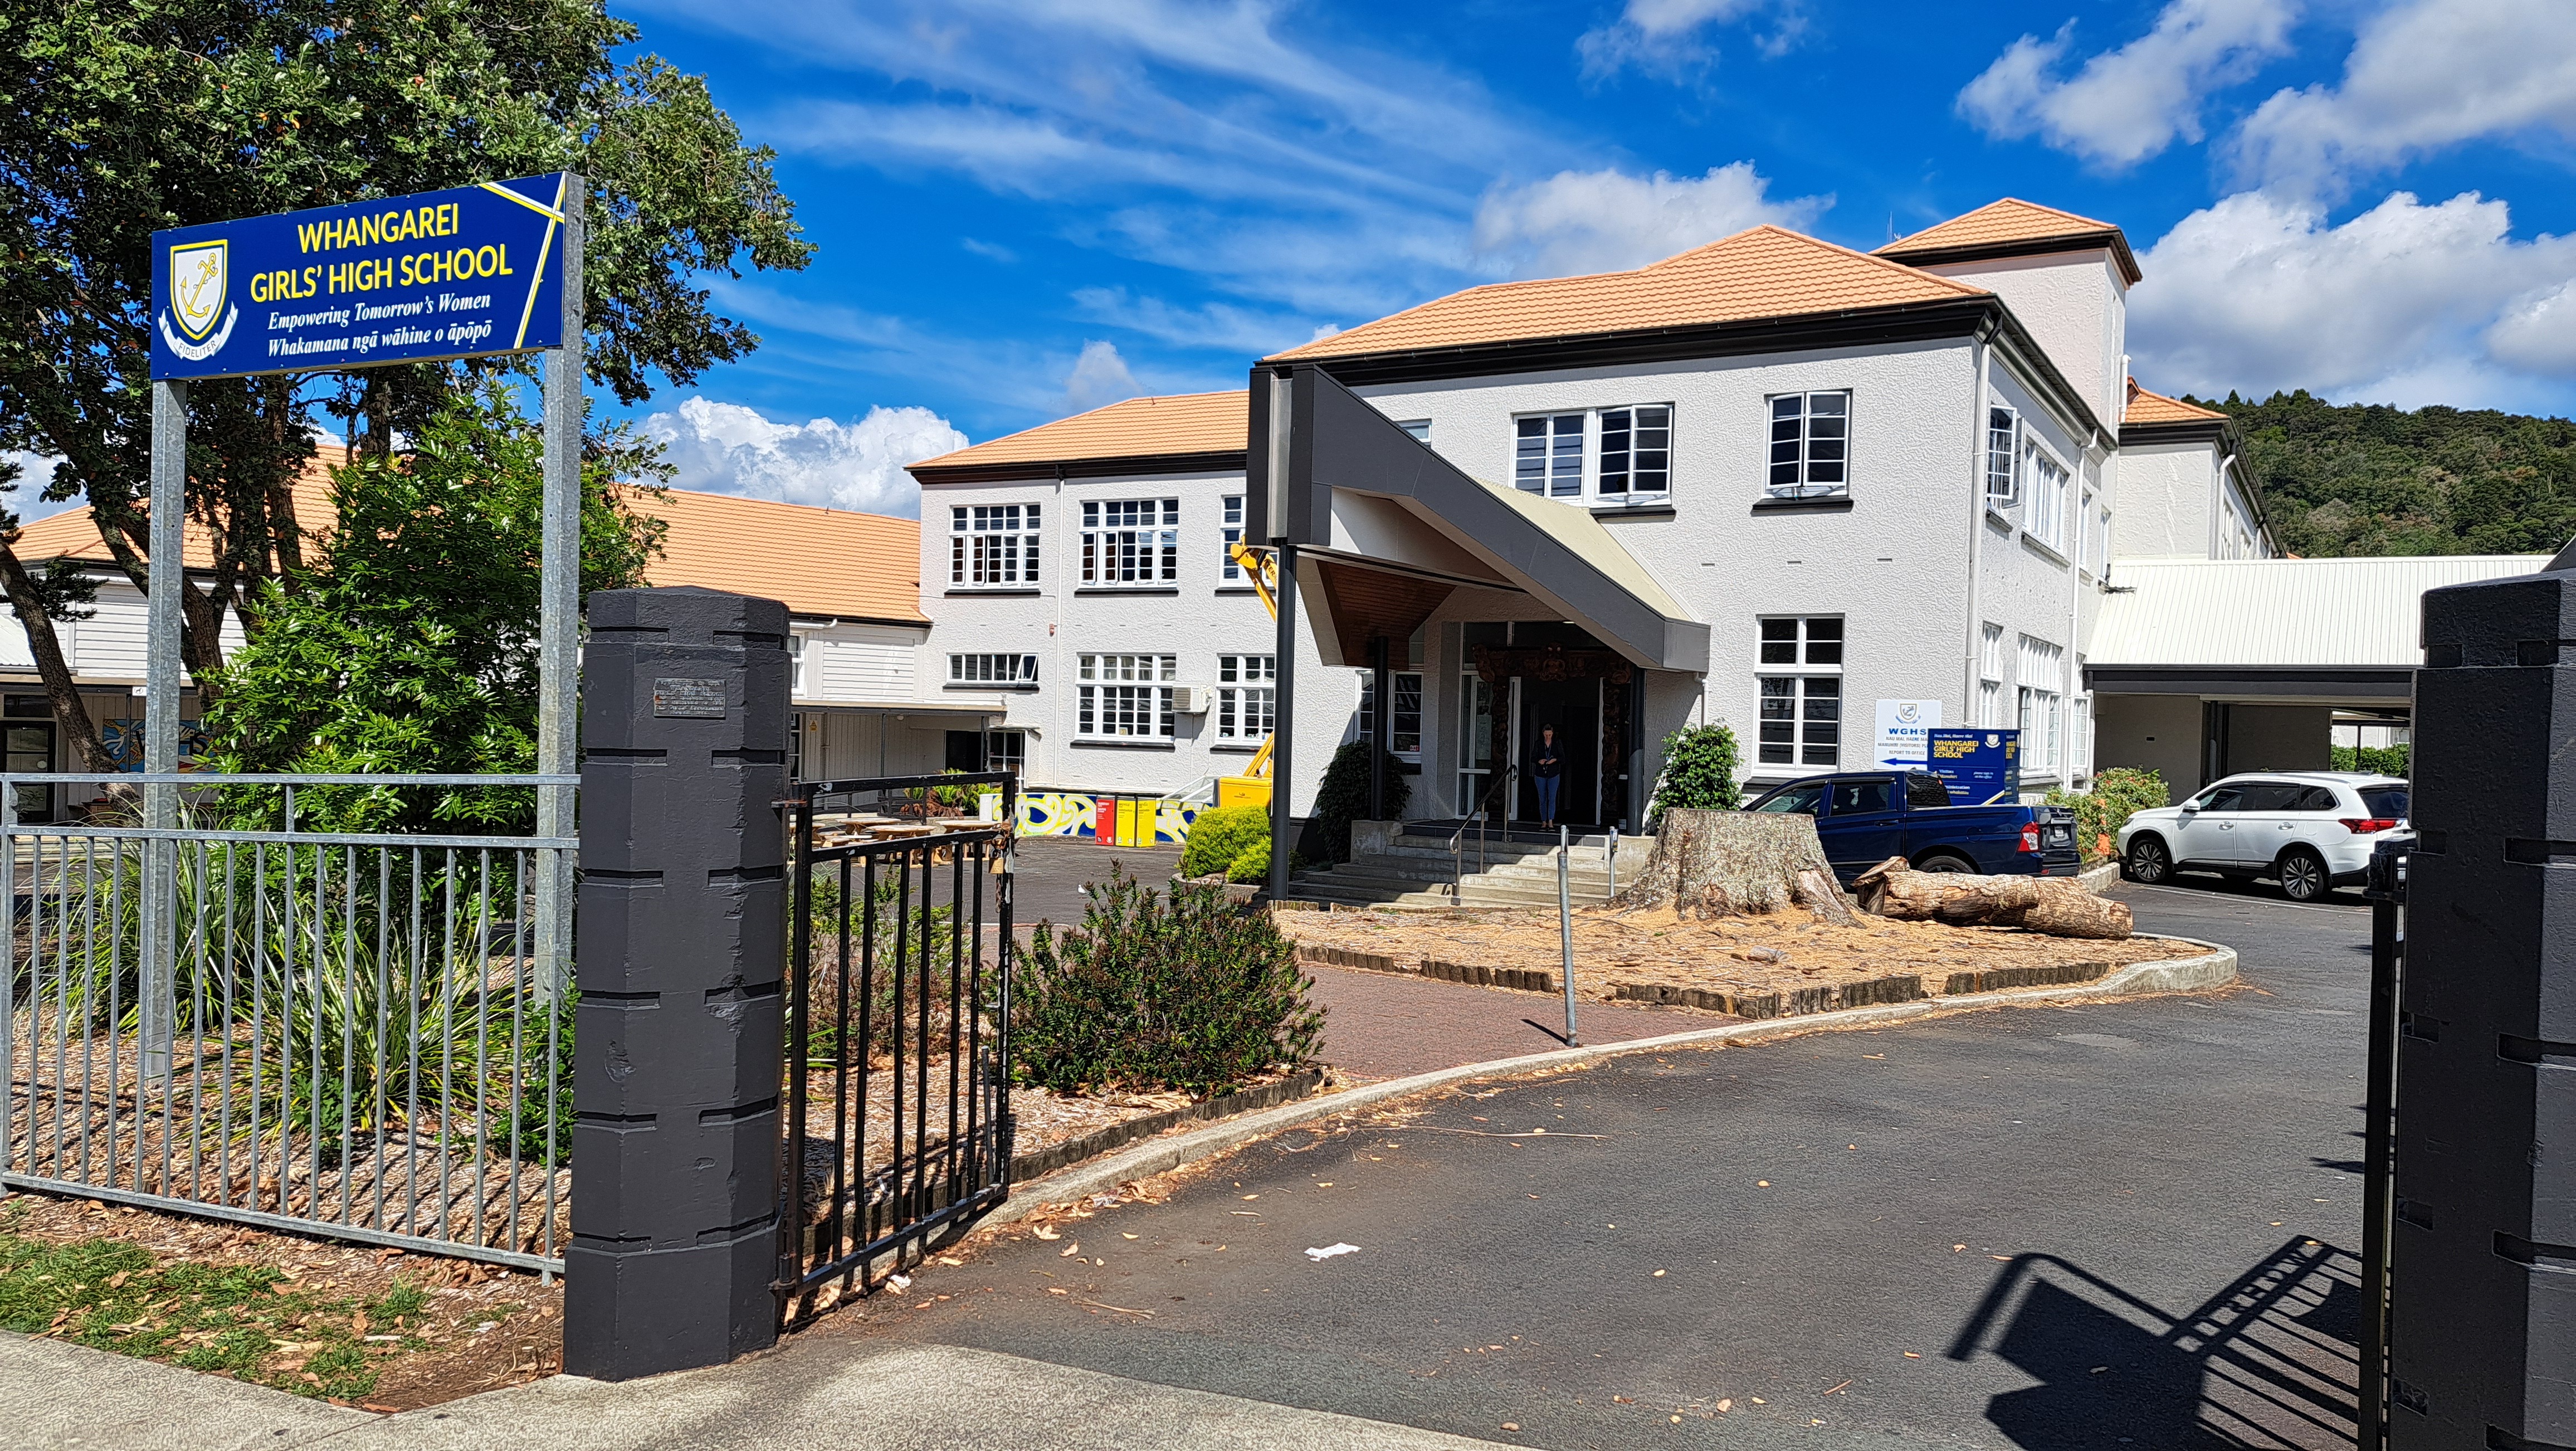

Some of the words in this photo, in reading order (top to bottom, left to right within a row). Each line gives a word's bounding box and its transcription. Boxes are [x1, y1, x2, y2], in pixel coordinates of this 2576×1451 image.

[297, 203, 458, 254] WHANGAREI
[329, 257, 393, 295] HIGH
[400, 244, 513, 286] SCHOOL
[267, 306, 350, 333] Empowering
[438, 293, 491, 313] Women
[178, 340, 217, 358] FIDELITER
[268, 336, 348, 357] Whakamana
[352, 331, 378, 350] ngā
[382, 326, 430, 347] wāhine
[435, 331, 443, 343] o
[447, 320, 492, 346] āpōpō
